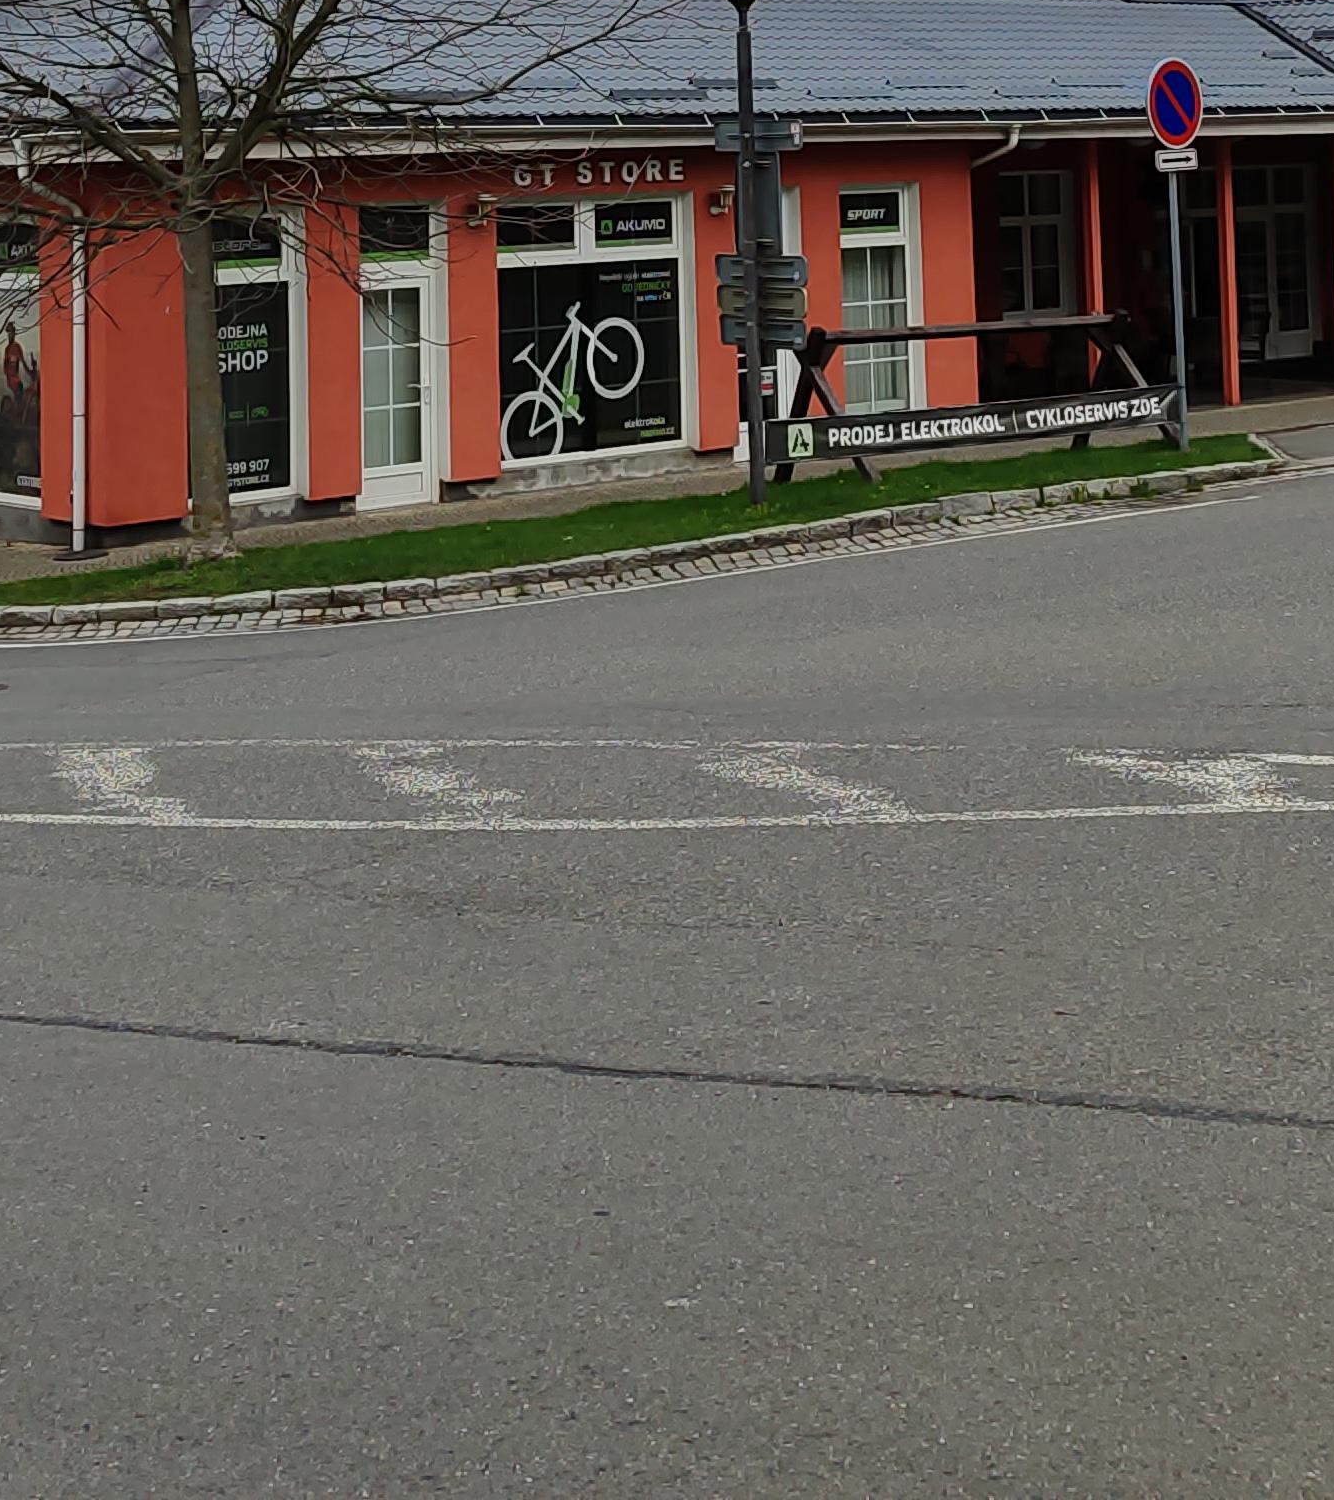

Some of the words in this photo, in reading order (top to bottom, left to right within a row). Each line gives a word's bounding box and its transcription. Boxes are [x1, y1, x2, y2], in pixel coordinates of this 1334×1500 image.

[514, 163, 556, 186] GT
[576, 159, 685, 184] STORE
[847, 208, 886, 220] SPORT
[616, 218, 665, 232] AKUMO
[218, 323, 267, 340] ODEJNA
[218, 350, 269, 373] SHOP
[828, 423, 894, 448] PRODEJ
[900, 413, 1005, 441] ELEKTROKOL
[1025, 401, 1128, 429] CYKLOSERVIS
[1131, 396, 1161, 417] ZDE
[249, 458, 269, 472] 907
